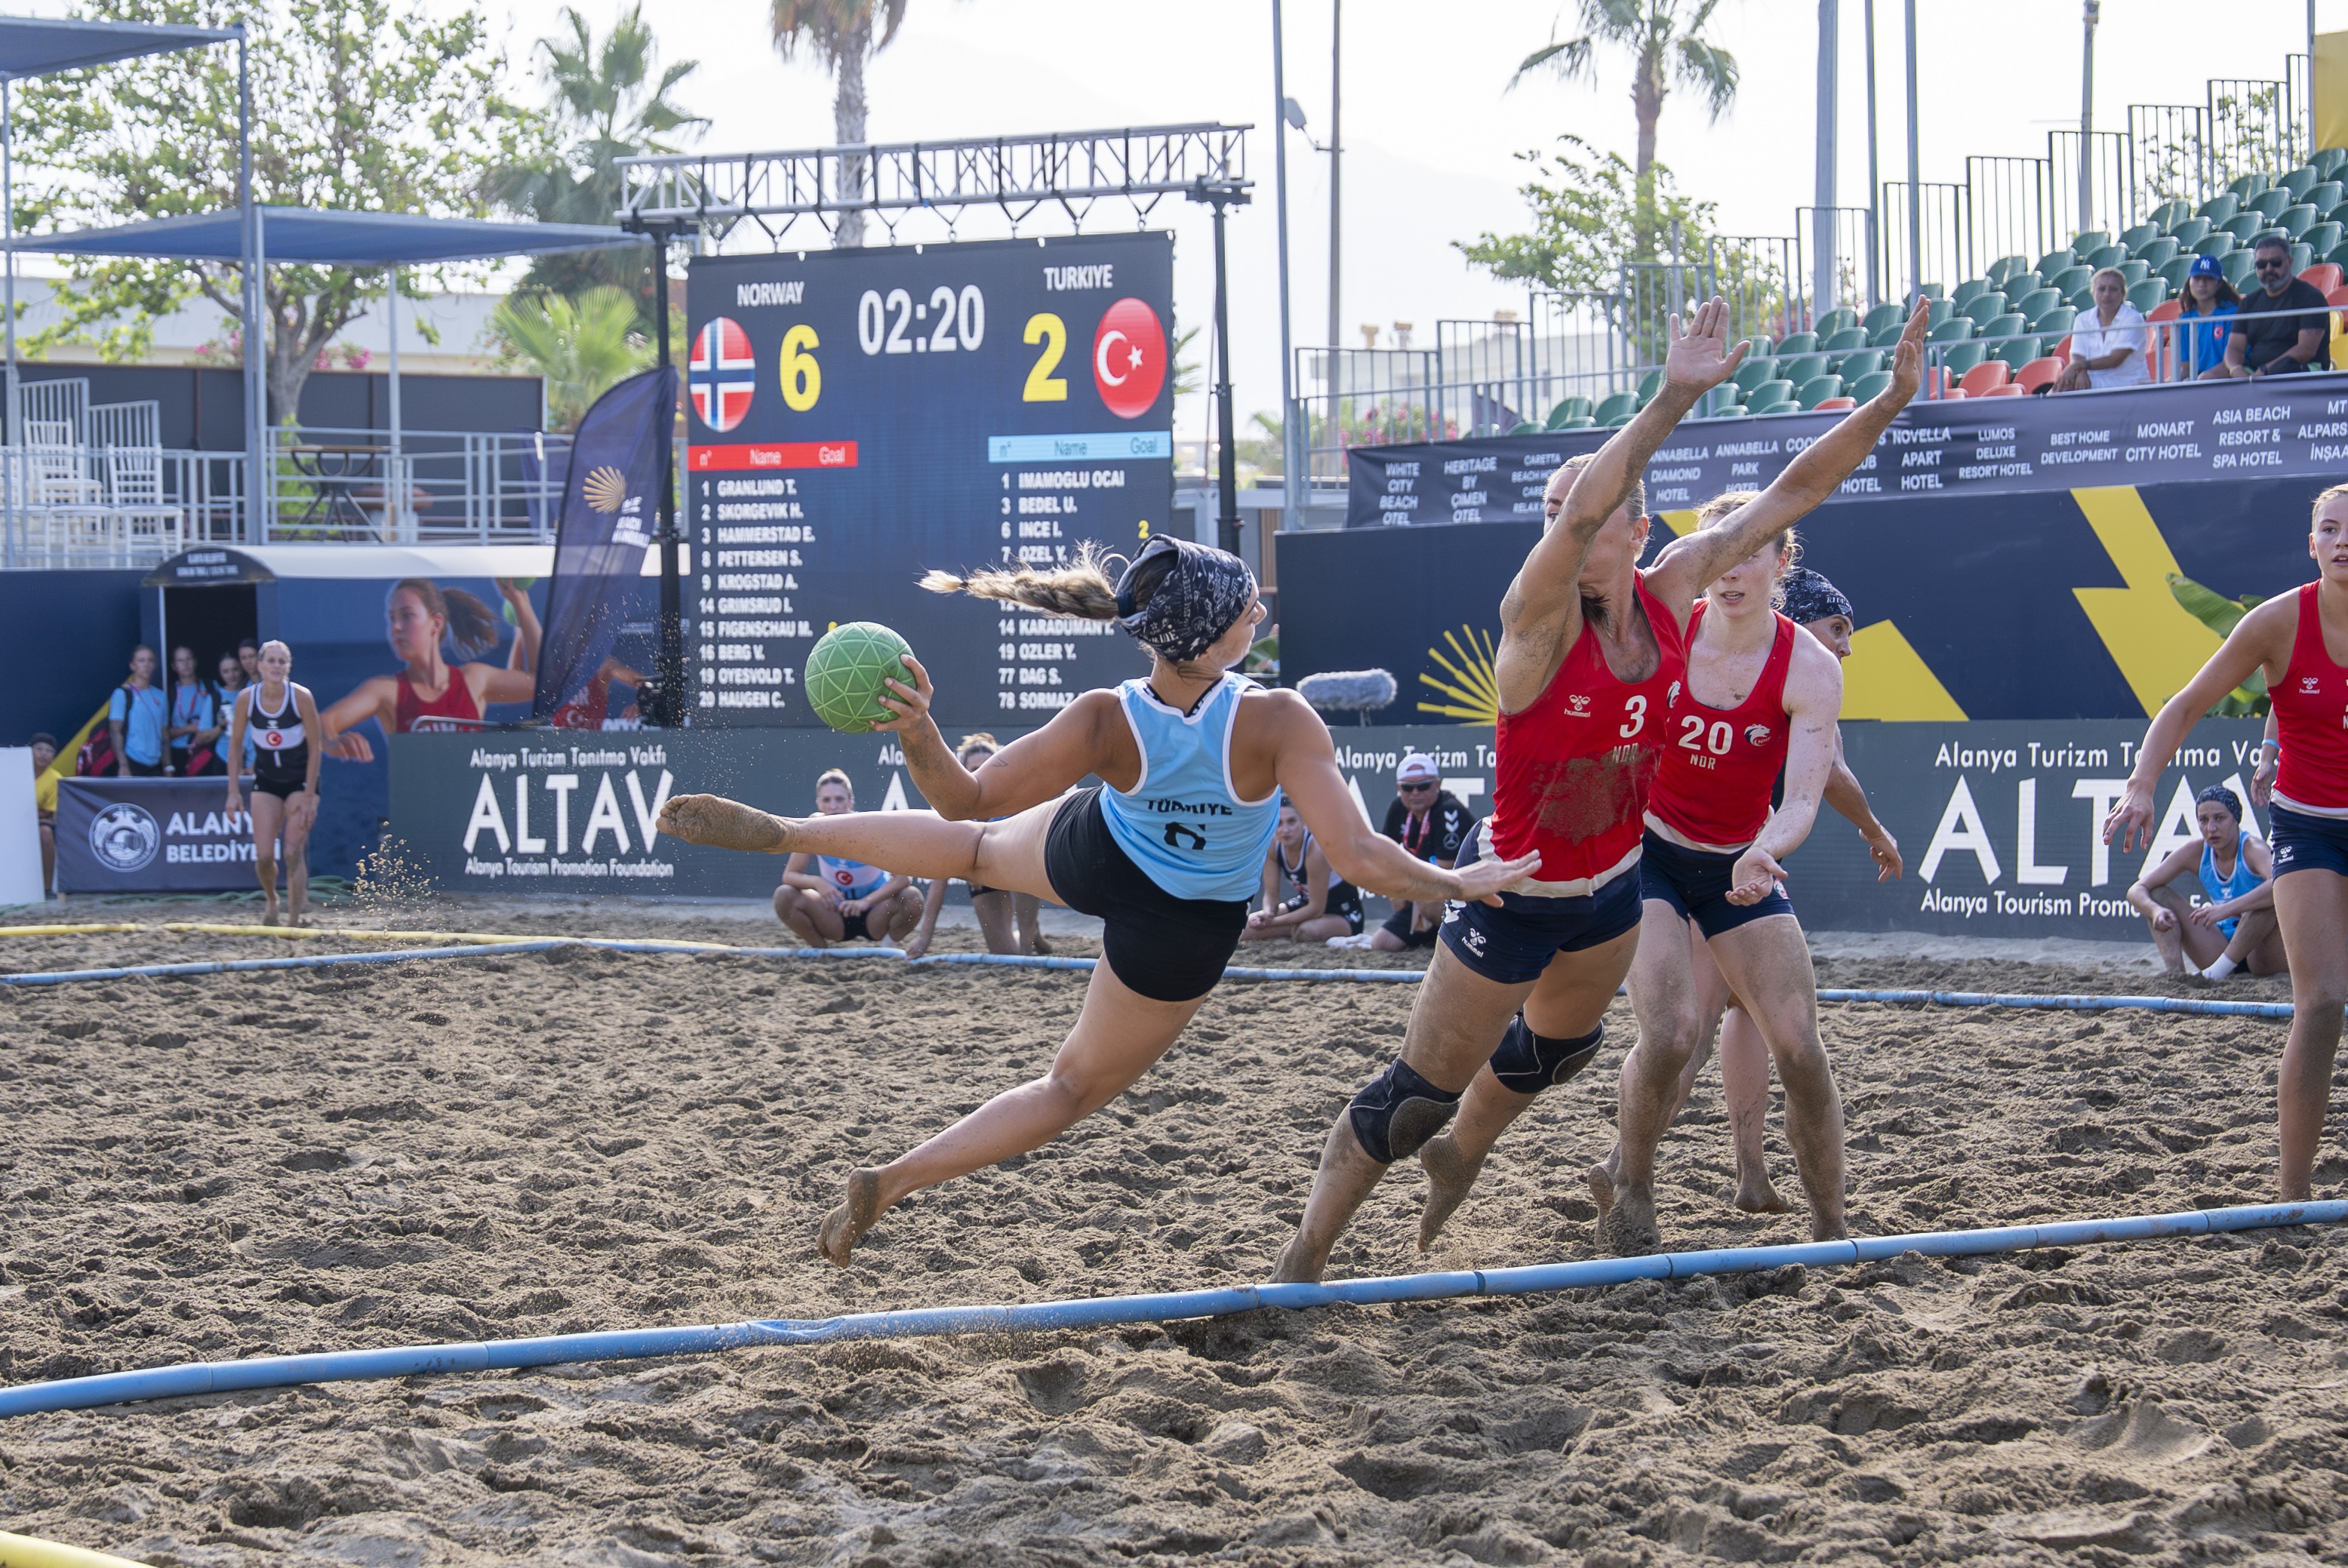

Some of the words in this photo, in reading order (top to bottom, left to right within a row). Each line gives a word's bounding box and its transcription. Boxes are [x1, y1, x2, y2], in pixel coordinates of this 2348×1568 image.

[1043, 264, 1113, 291] TURKIYE
[737, 281, 805, 306] NORWAY
[858, 284, 985, 356] 02:20
[1023, 312, 1067, 402] 2
[780, 324, 821, 411] 6
[2212, 408, 2242, 426] ASIA
[2245, 405, 2291, 423] BEACH
[2327, 399, 2348, 415] MT
[1892, 426, 1952, 445] NOVELLA
[1977, 427, 2016, 443] LUMOS
[2050, 432, 2077, 447] BEST
[2078, 429, 2110, 445] HOME
[2137, 420, 2195, 439] MONART
[2219, 429, 2270, 447] RESORT
[2271, 428, 2282, 443] &
[2297, 421, 2348, 440] ALPARS
[749, 448, 781, 466] Name
[819, 445, 845, 465] Goal
[1054, 439, 1088, 457] Name
[1130, 436, 1158, 454] Goal
[1715, 440, 1780, 458] ANNABELLA
[1976, 445, 2016, 460] DELUXE
[2125, 445, 2156, 463] CITY
[2158, 443, 2202, 460] HOTEL
[1523, 453, 1562, 467] CARETTA
[1900, 450, 1943, 467] APART
[2041, 447, 2119, 465] DEVELOPMENT
[2212, 453, 2237, 469] SPA
[2239, 450, 2282, 467] HOTEL
[1385, 463, 1420, 478] WHITE
[1444, 456, 1497, 475] HERITAGE
[1731, 461, 1759, 477] PARK
[1959, 464, 1998, 480] RESORT
[1999, 463, 2033, 478] HOTEL
[1001, 472, 1010, 490] 1
[1018, 471, 1090, 490] IMAMOGLU
[1462, 474, 1478, 490] BY
[1511, 470, 1540, 483] BEACH
[1651, 467, 1701, 484] DIAMOND
[1900, 474, 1943, 490] HOTEL
[701, 481, 710, 497] 1
[717, 479, 785, 497] GRANLUND
[1387, 478, 1414, 494] CITY
[1841, 477, 1882, 494] HOTEL
[1379, 495, 1419, 511] BEACH
[1655, 487, 1691, 503] HOTEL
[701, 503, 711, 521] 2
[1001, 497, 1011, 515] 3
[1018, 497, 1061, 514] BEDEL
[1382, 511, 1411, 527] OTEL
[1452, 507, 1482, 524] OTEL
[701, 527, 711, 545] 3
[717, 526, 802, 545] HAMMERSTAD
[802, 525, 816, 543] E.
[1001, 521, 1011, 539] 6
[1019, 521, 1051, 539] INCE
[1138, 520, 1149, 539] 2
[701, 551, 711, 567] 8
[717, 549, 789, 567] PETTERSEN
[789, 549, 803, 567] S.
[1001, 546, 1011, 563] 7
[1018, 546, 1054, 563] OZEL
[701, 574, 711, 592] 9
[718, 573, 784, 591] KROGSTAD
[784, 573, 799, 590] A.
[698, 597, 715, 614] 14
[698, 621, 715, 638] 15
[718, 620, 796, 638] FIGENSCHAU
[998, 619, 1015, 636] 14
[1019, 619, 1103, 636] KARADUMAN
[698, 644, 715, 661] 16
[718, 644, 752, 661] BERG
[998, 643, 1015, 660] 19
[1019, 643, 1063, 660] OZLER
[698, 668, 715, 684] 19
[998, 668, 1015, 684] 77
[1019, 667, 1047, 685] DAG
[698, 691, 715, 708] 20
[718, 690, 770, 709] HAUGEN
[1564, 708, 1591, 718] hummel
[1619, 694, 1648, 739] 3
[1678, 715, 1734, 755] 20
[469, 746, 518, 773] Alanya
[520, 746, 566, 768] Turizm
[1334, 746, 1396, 773] Alanya
[1612, 742, 1639, 764] NOR
[1689, 753, 1716, 770] NOR
[1934, 738, 2017, 774] Alanya
[2028, 742, 2108, 768] Turizm
[2120, 741, 2221, 768] Tatma
[463, 768, 674, 855] ALTAV
[165, 810, 254, 836] ALANY
[465, 856, 504, 879] Alanya
[505, 857, 550, 878] Tourism
[551, 858, 608, 878] Promotion
[609, 858, 675, 878] Foundation
[1921, 887, 1988, 919] Alanya
[1993, 890, 2072, 917] Tourism
[1461, 936, 1484, 958] hummel
